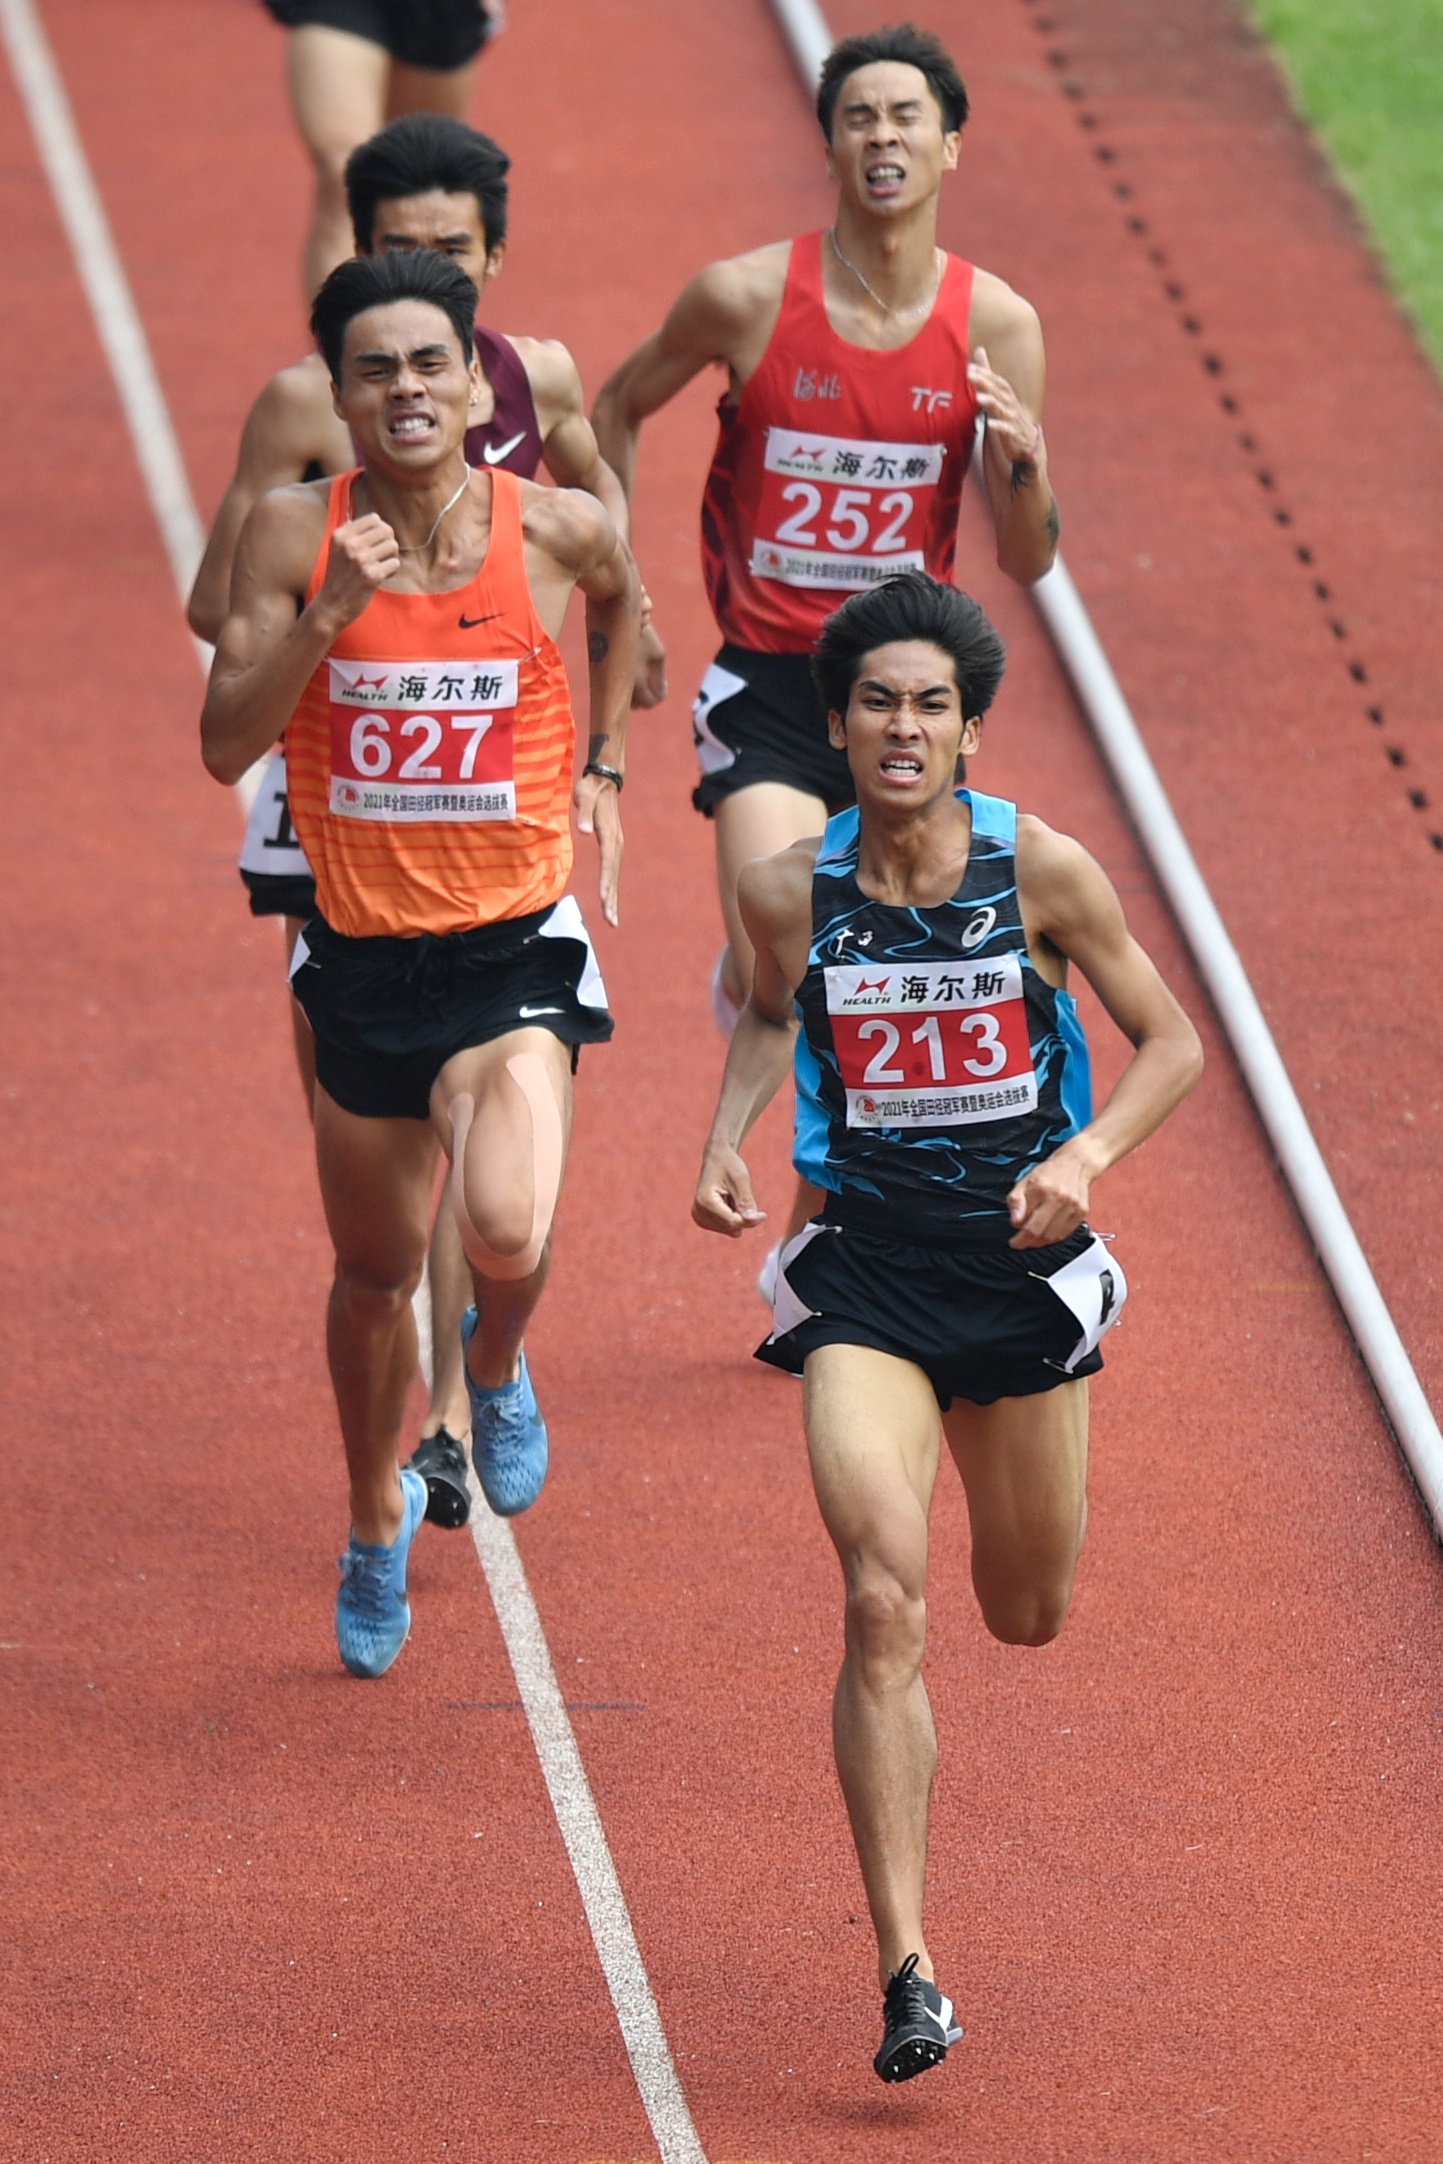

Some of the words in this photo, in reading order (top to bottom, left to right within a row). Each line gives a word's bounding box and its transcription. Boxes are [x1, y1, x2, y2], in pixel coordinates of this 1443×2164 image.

[832, 450, 930, 480] 海尔斯
[775, 482, 914, 553] 252
[341, 689, 389, 702] HEALTH
[398, 675, 503, 702] 海尔斯
[350, 713, 493, 779] 627
[843, 996, 891, 1006] HEALTH
[900, 971, 1006, 1004] 海尔斯
[858, 1012, 1007, 1084] 213
